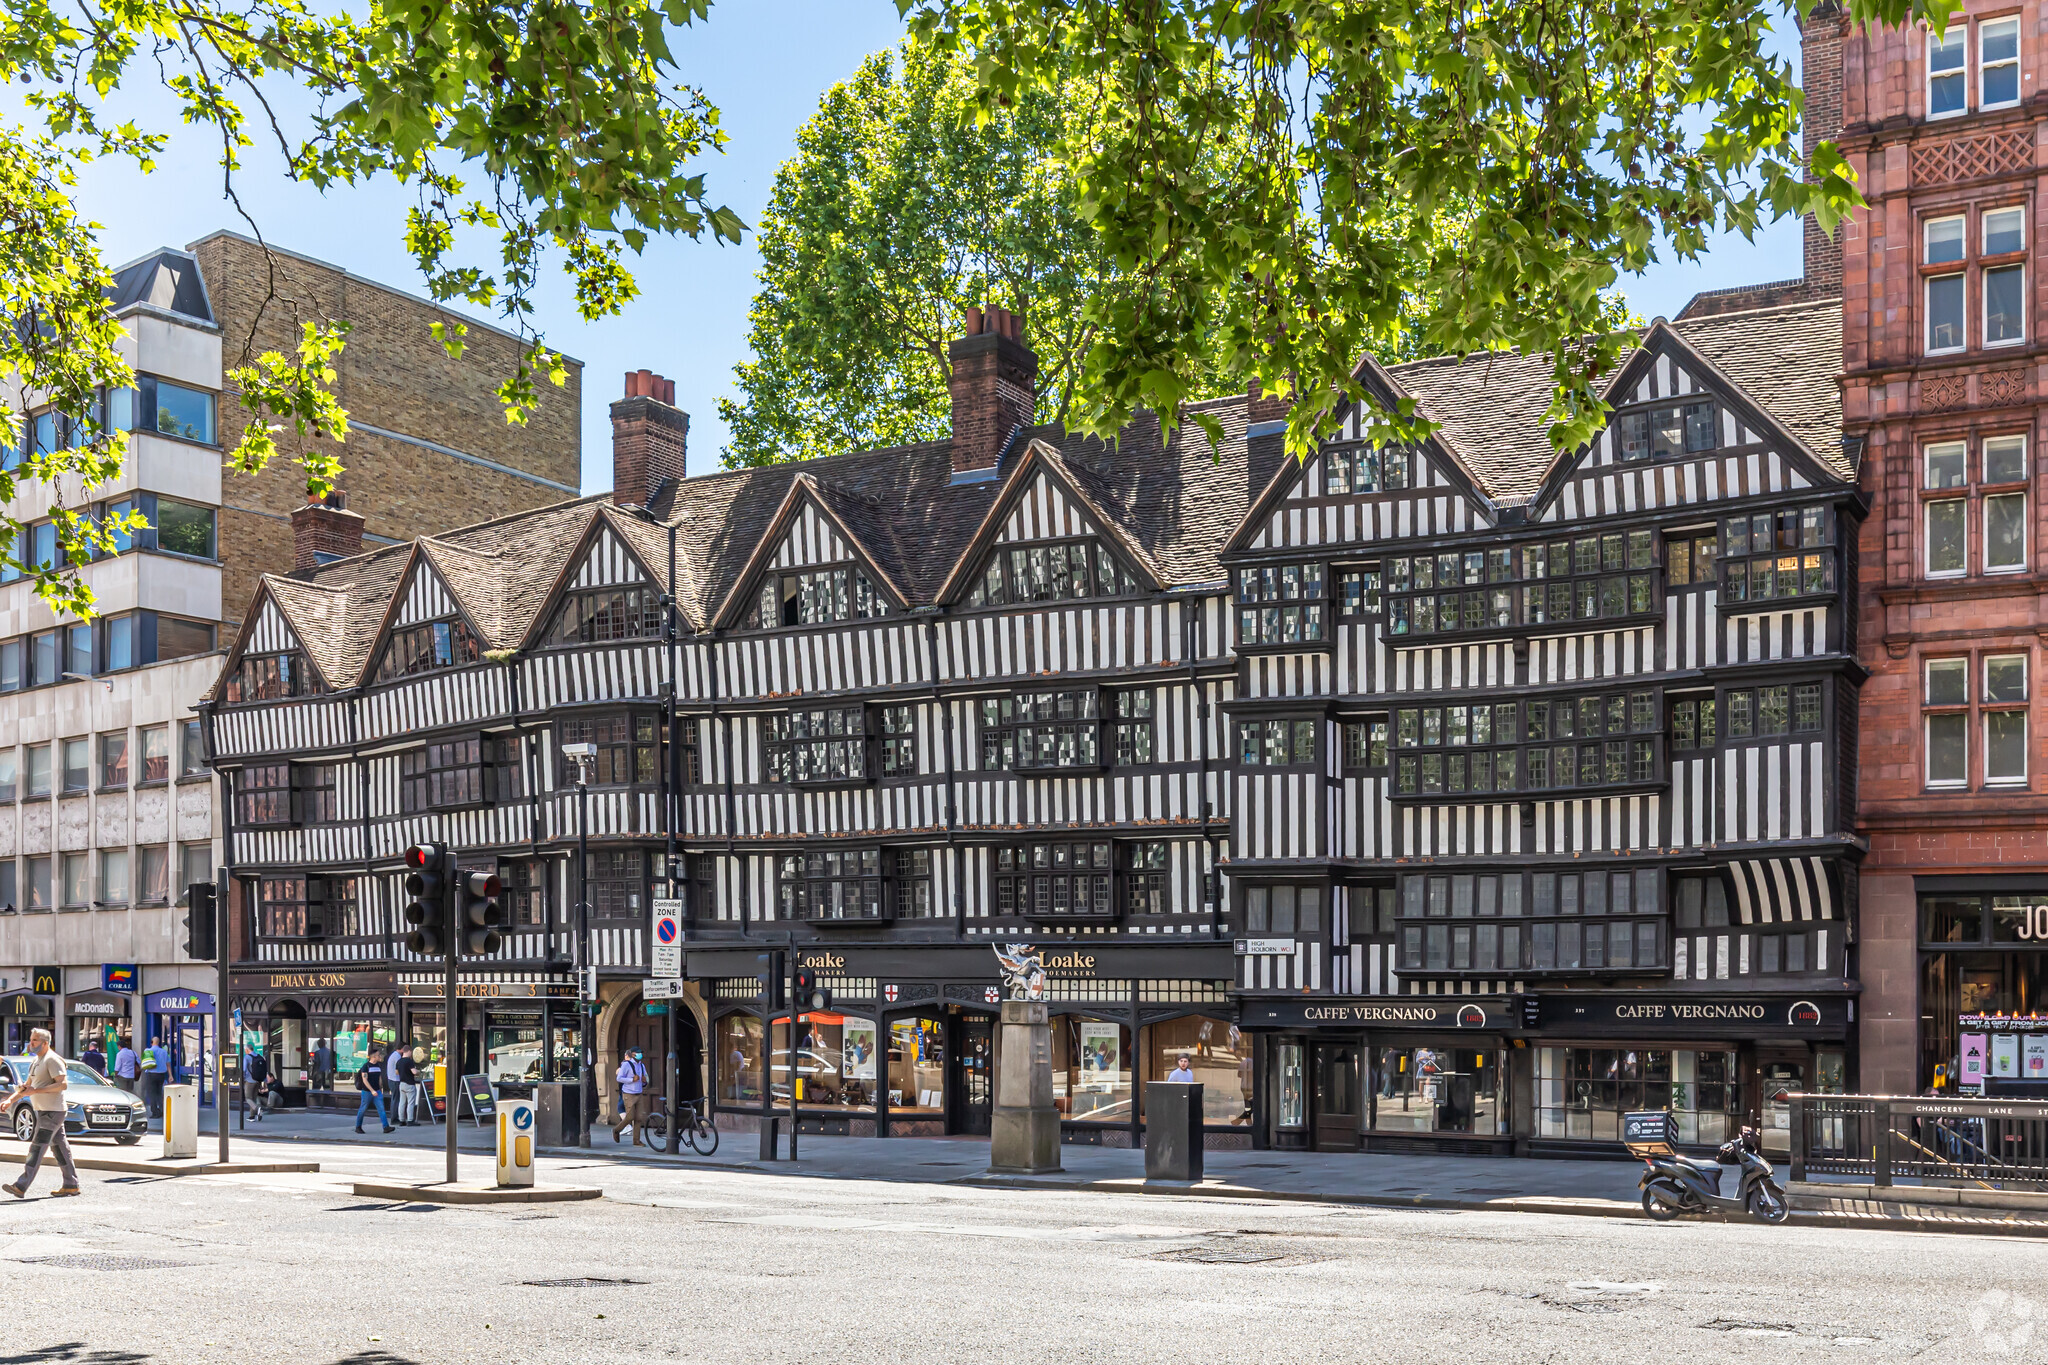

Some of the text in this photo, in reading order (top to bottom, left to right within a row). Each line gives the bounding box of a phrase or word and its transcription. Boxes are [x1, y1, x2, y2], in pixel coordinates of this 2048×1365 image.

[1038, 951, 1095, 968] Loake
[270, 973, 346, 988] LIPMAN & SONS
[404, 984, 537, 996] 3 SNFORD 3
[75, 1002, 114, 1013] McDonald's
[160, 998, 188, 1009] CORAL
[1304, 1007, 1436, 1020] CAFFE' VERGNANO
[1616, 1005, 1765, 1018] CAFFE' VERGNANO
